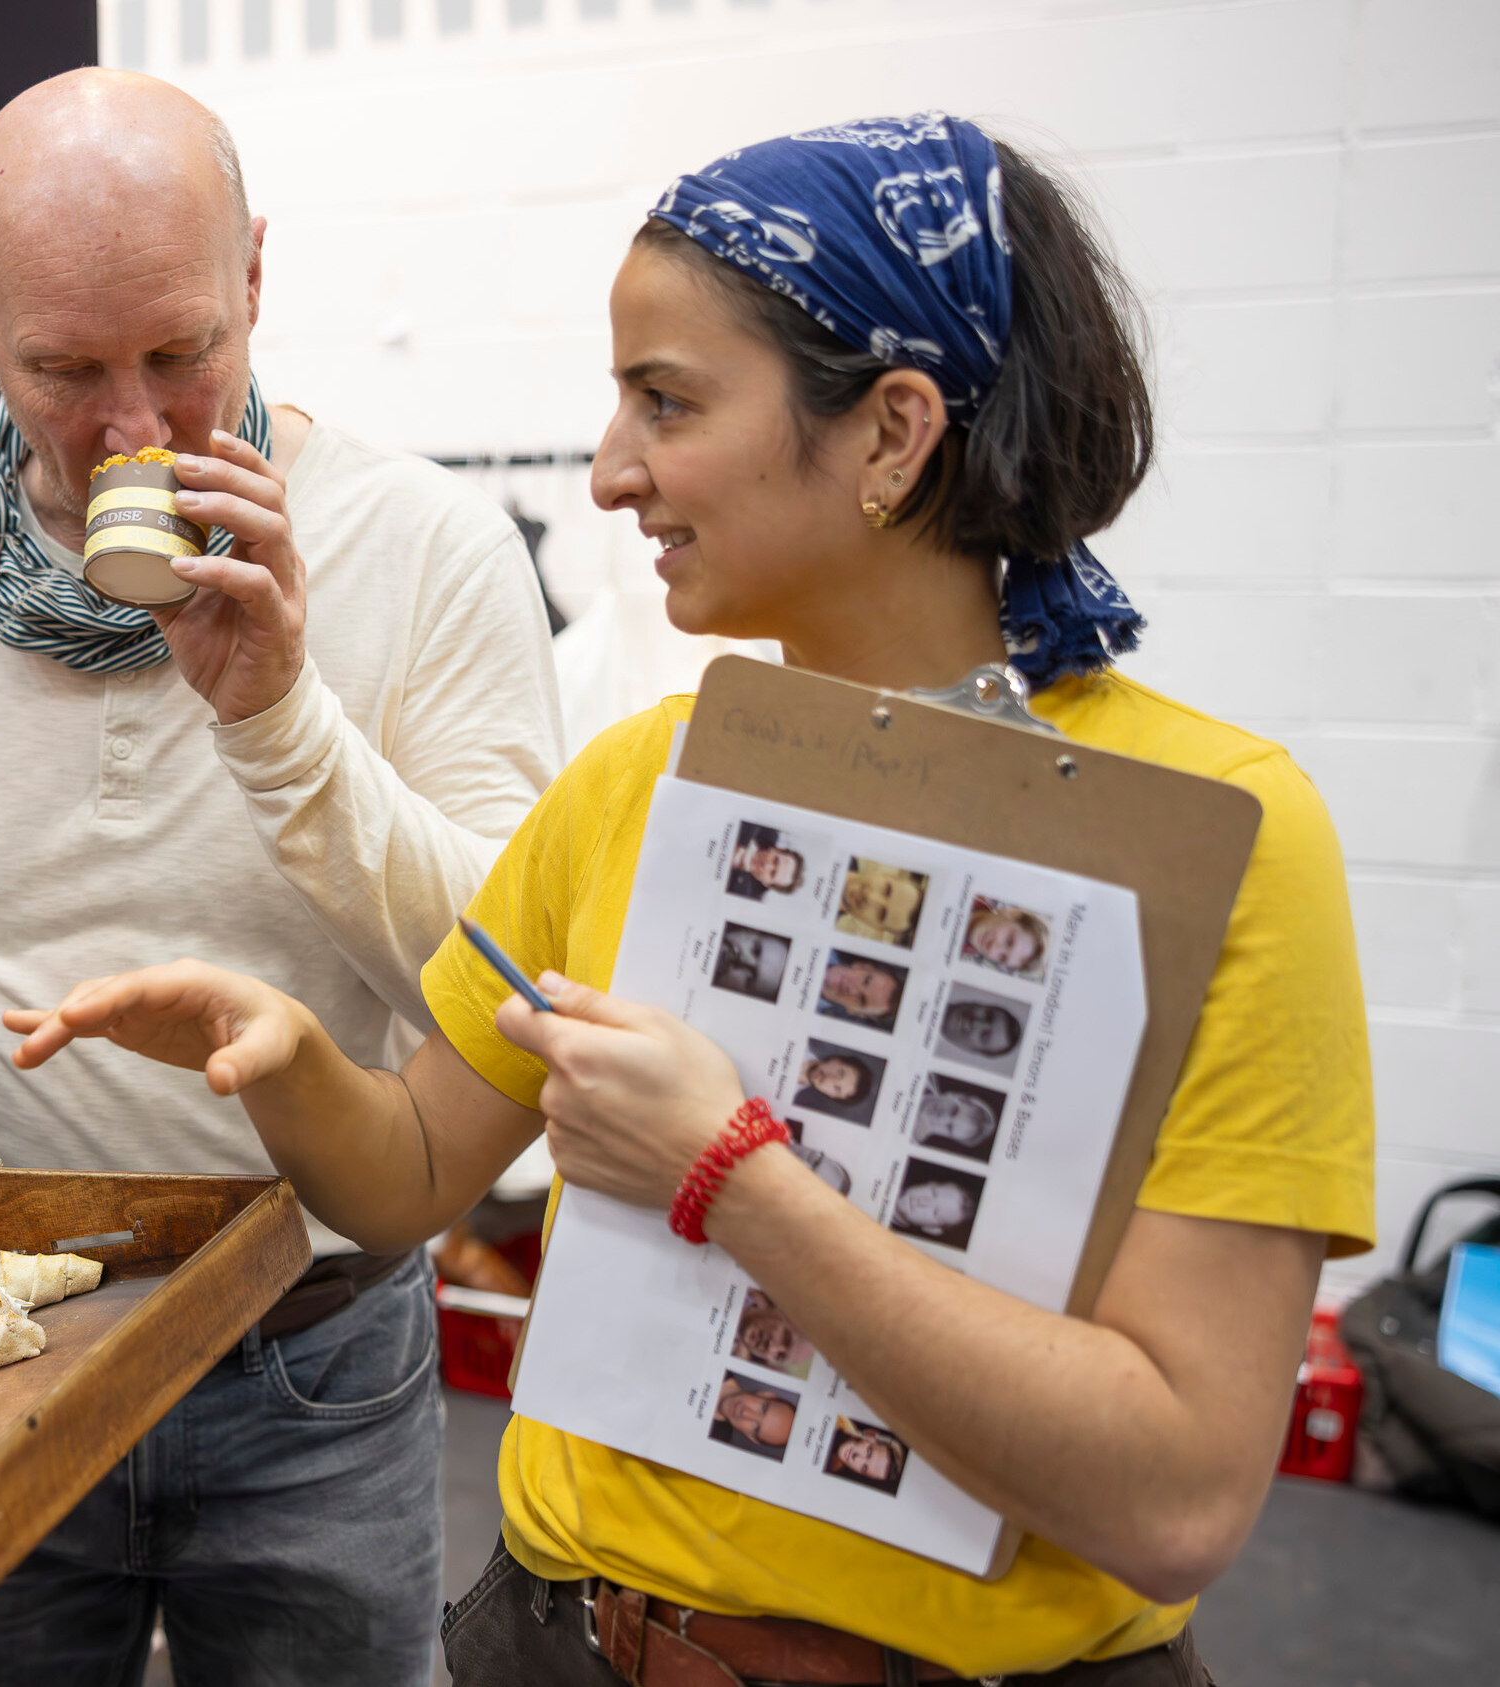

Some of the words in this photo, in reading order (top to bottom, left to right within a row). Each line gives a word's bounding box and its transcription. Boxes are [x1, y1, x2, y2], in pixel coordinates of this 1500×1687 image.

[1060, 902, 1086, 946] Marx
[1056, 948, 1073, 965] in
[1036, 968, 1069, 1034] London!
[1022, 1037, 1050, 1089] Tenors
[1020, 1092, 1036, 1106] &
[1003, 1109, 1032, 1162] Basses
